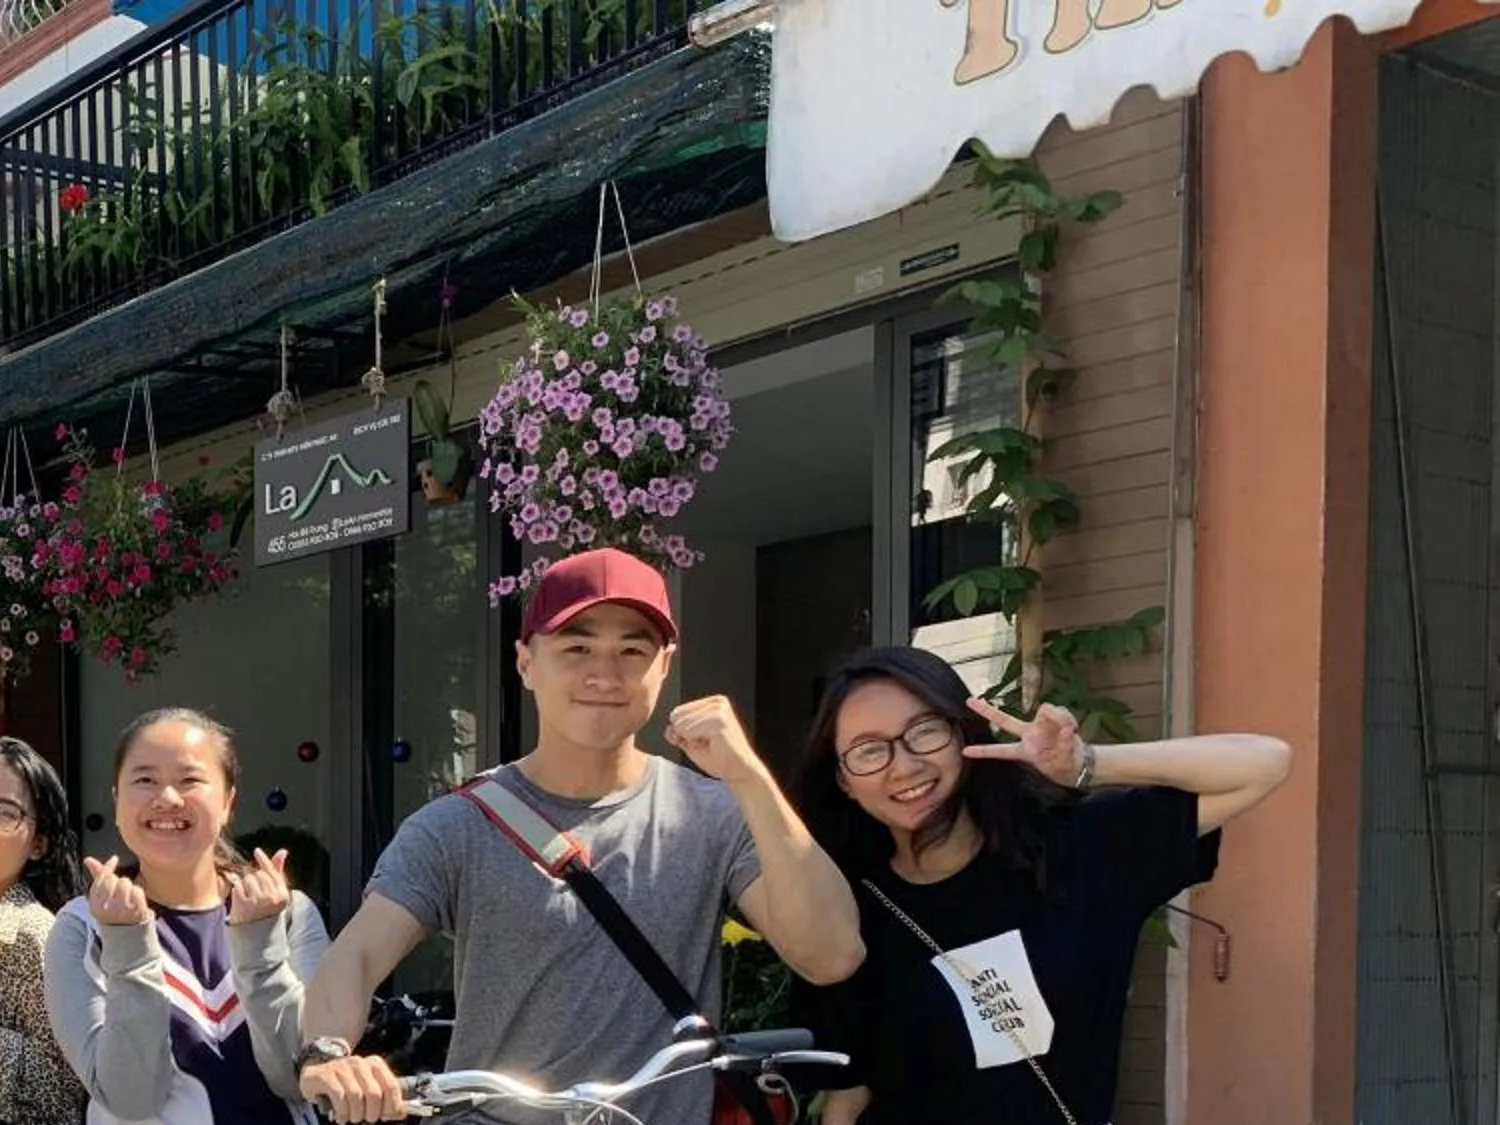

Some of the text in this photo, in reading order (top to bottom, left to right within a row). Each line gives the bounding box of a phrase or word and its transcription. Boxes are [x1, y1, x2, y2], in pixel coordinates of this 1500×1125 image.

[265, 482, 297, 515] La
[971, 967, 999, 989] ANTI
[979, 997, 1022, 1021] SOCIAL
